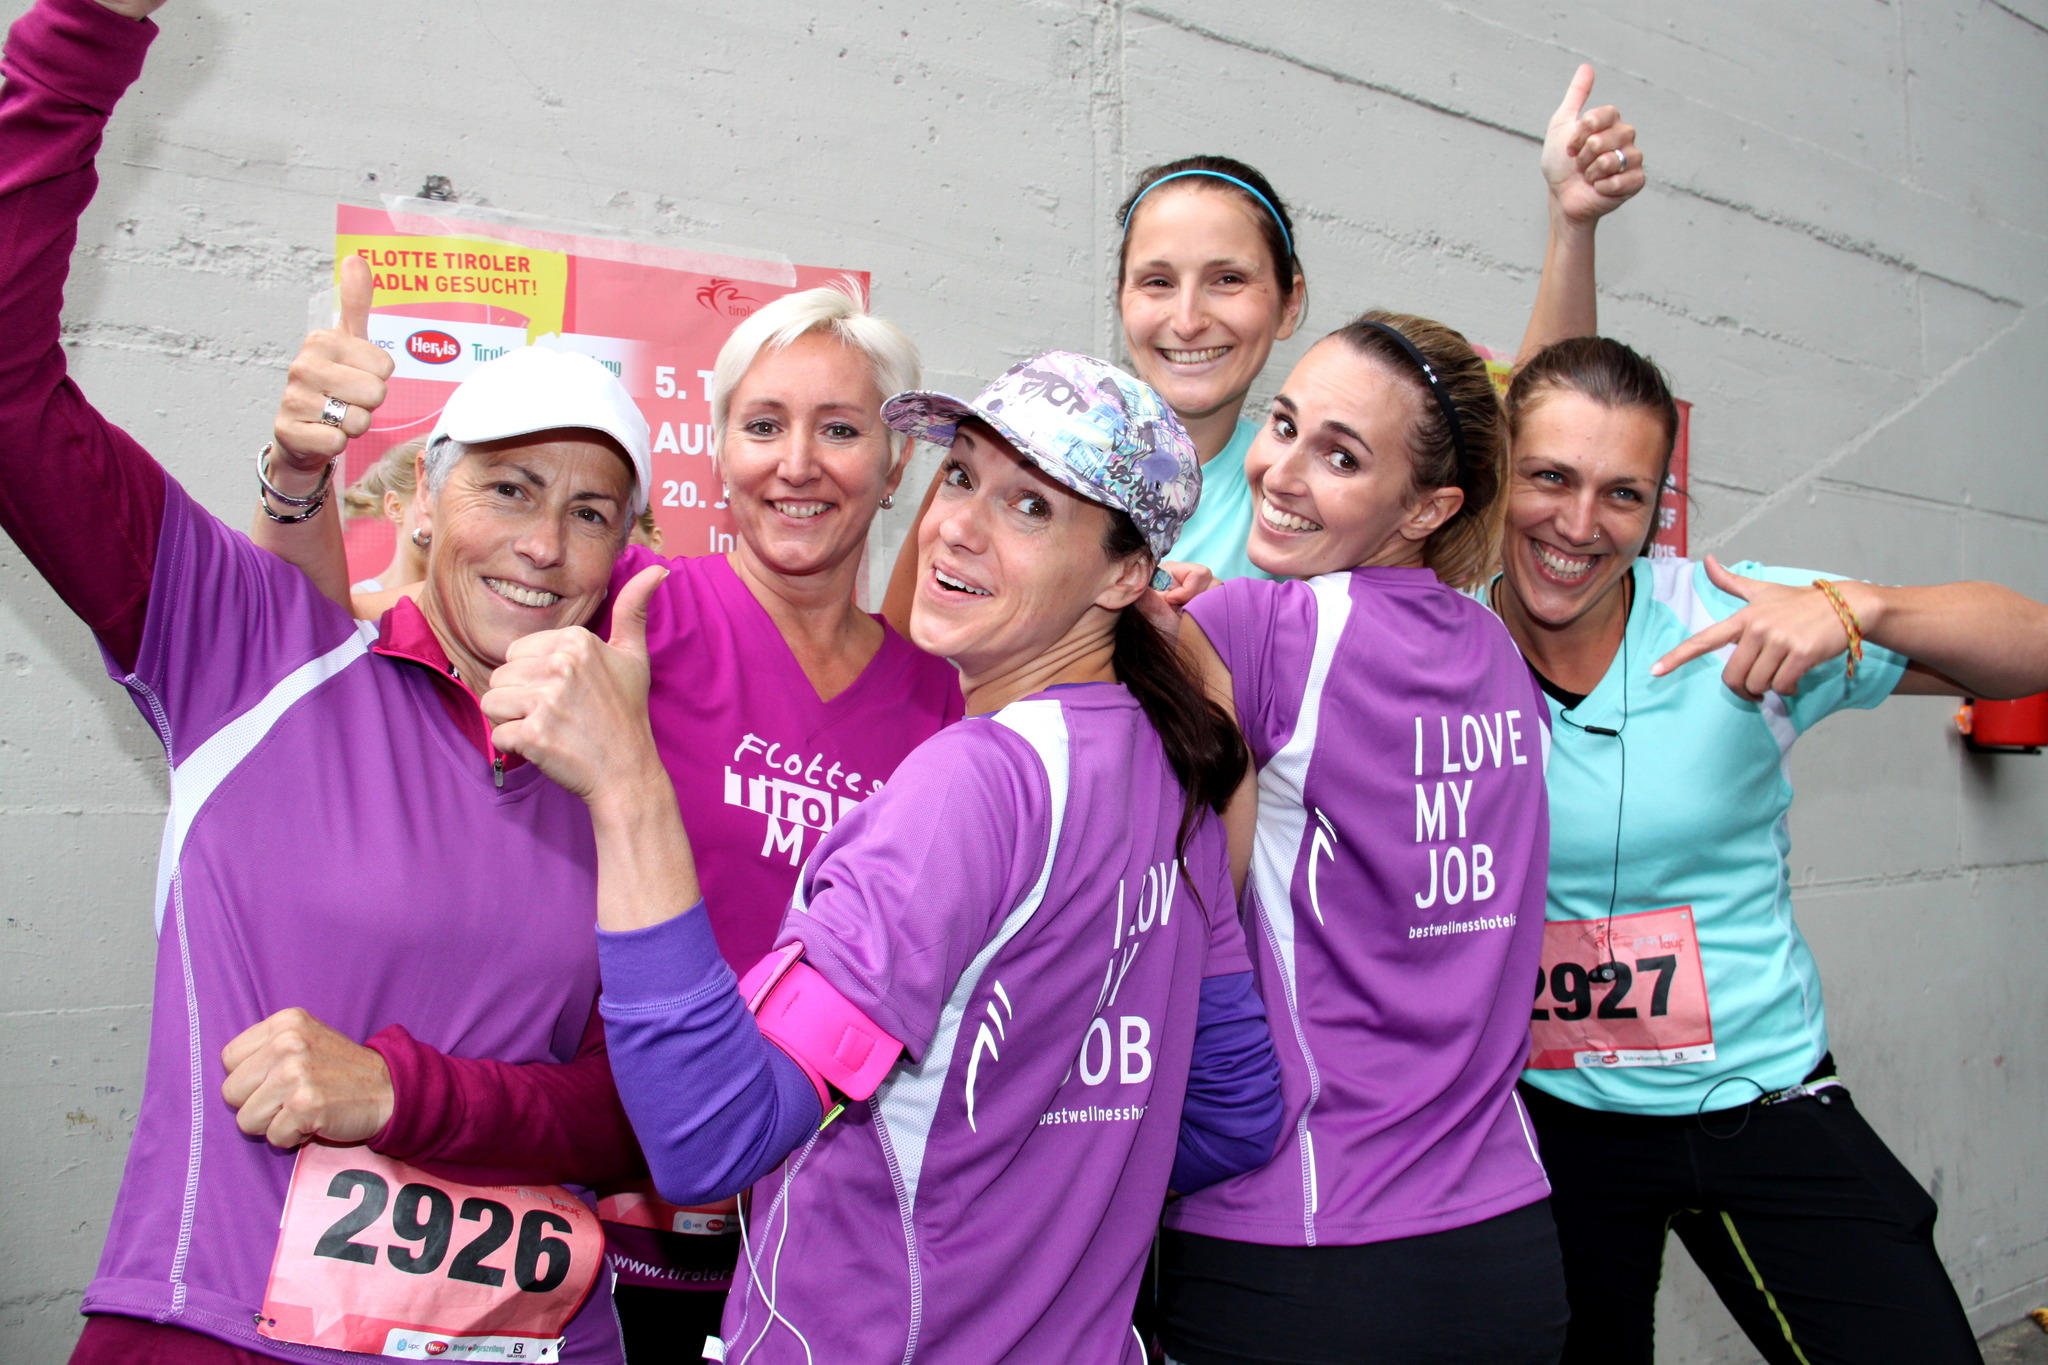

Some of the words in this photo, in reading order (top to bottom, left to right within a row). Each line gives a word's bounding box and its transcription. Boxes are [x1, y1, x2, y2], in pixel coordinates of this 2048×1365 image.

[443, 252, 531, 273] TIROLER
[373, 273, 429, 292] ADLN
[435, 275, 537, 296] GESUCHT!
[411, 336, 457, 358] Hervis
[655, 365, 687, 400] 5.
[652, 421, 714, 456] AU
[661, 480, 706, 508] 20.
[709, 525, 740, 553] In
[1414, 716, 1423, 776] I
[1441, 709, 1528, 773] LOVE
[1415, 779, 1473, 843] MY
[1414, 843, 1496, 909] JOB
[1113, 879, 1124, 950] I
[1059, 1016, 1152, 1086] OB
[313, 1168, 573, 1294] 2926
